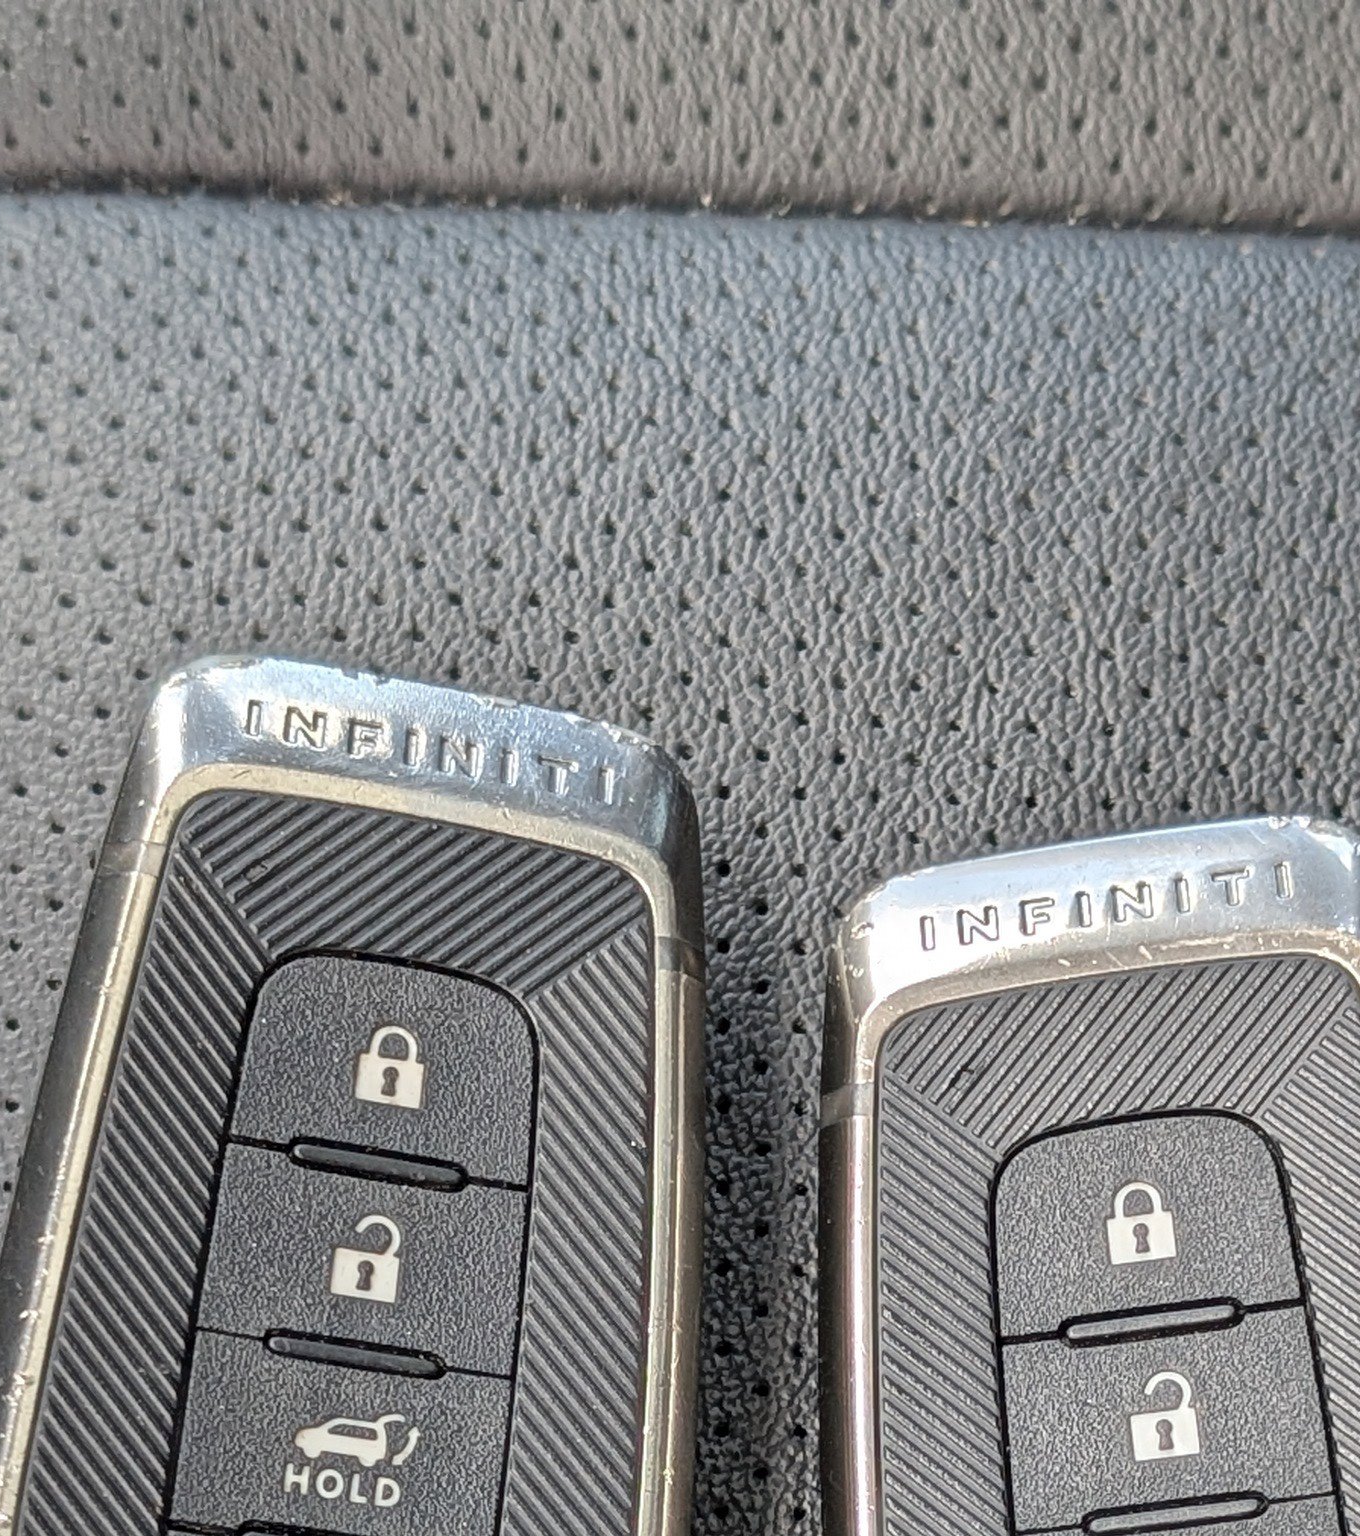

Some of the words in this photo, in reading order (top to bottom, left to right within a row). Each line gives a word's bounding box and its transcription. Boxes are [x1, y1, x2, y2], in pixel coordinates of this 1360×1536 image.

[245, 698, 616, 804] INFINITI
[919, 860, 1296, 952] INFINITI
[283, 1463, 401, 1507] HOLD
